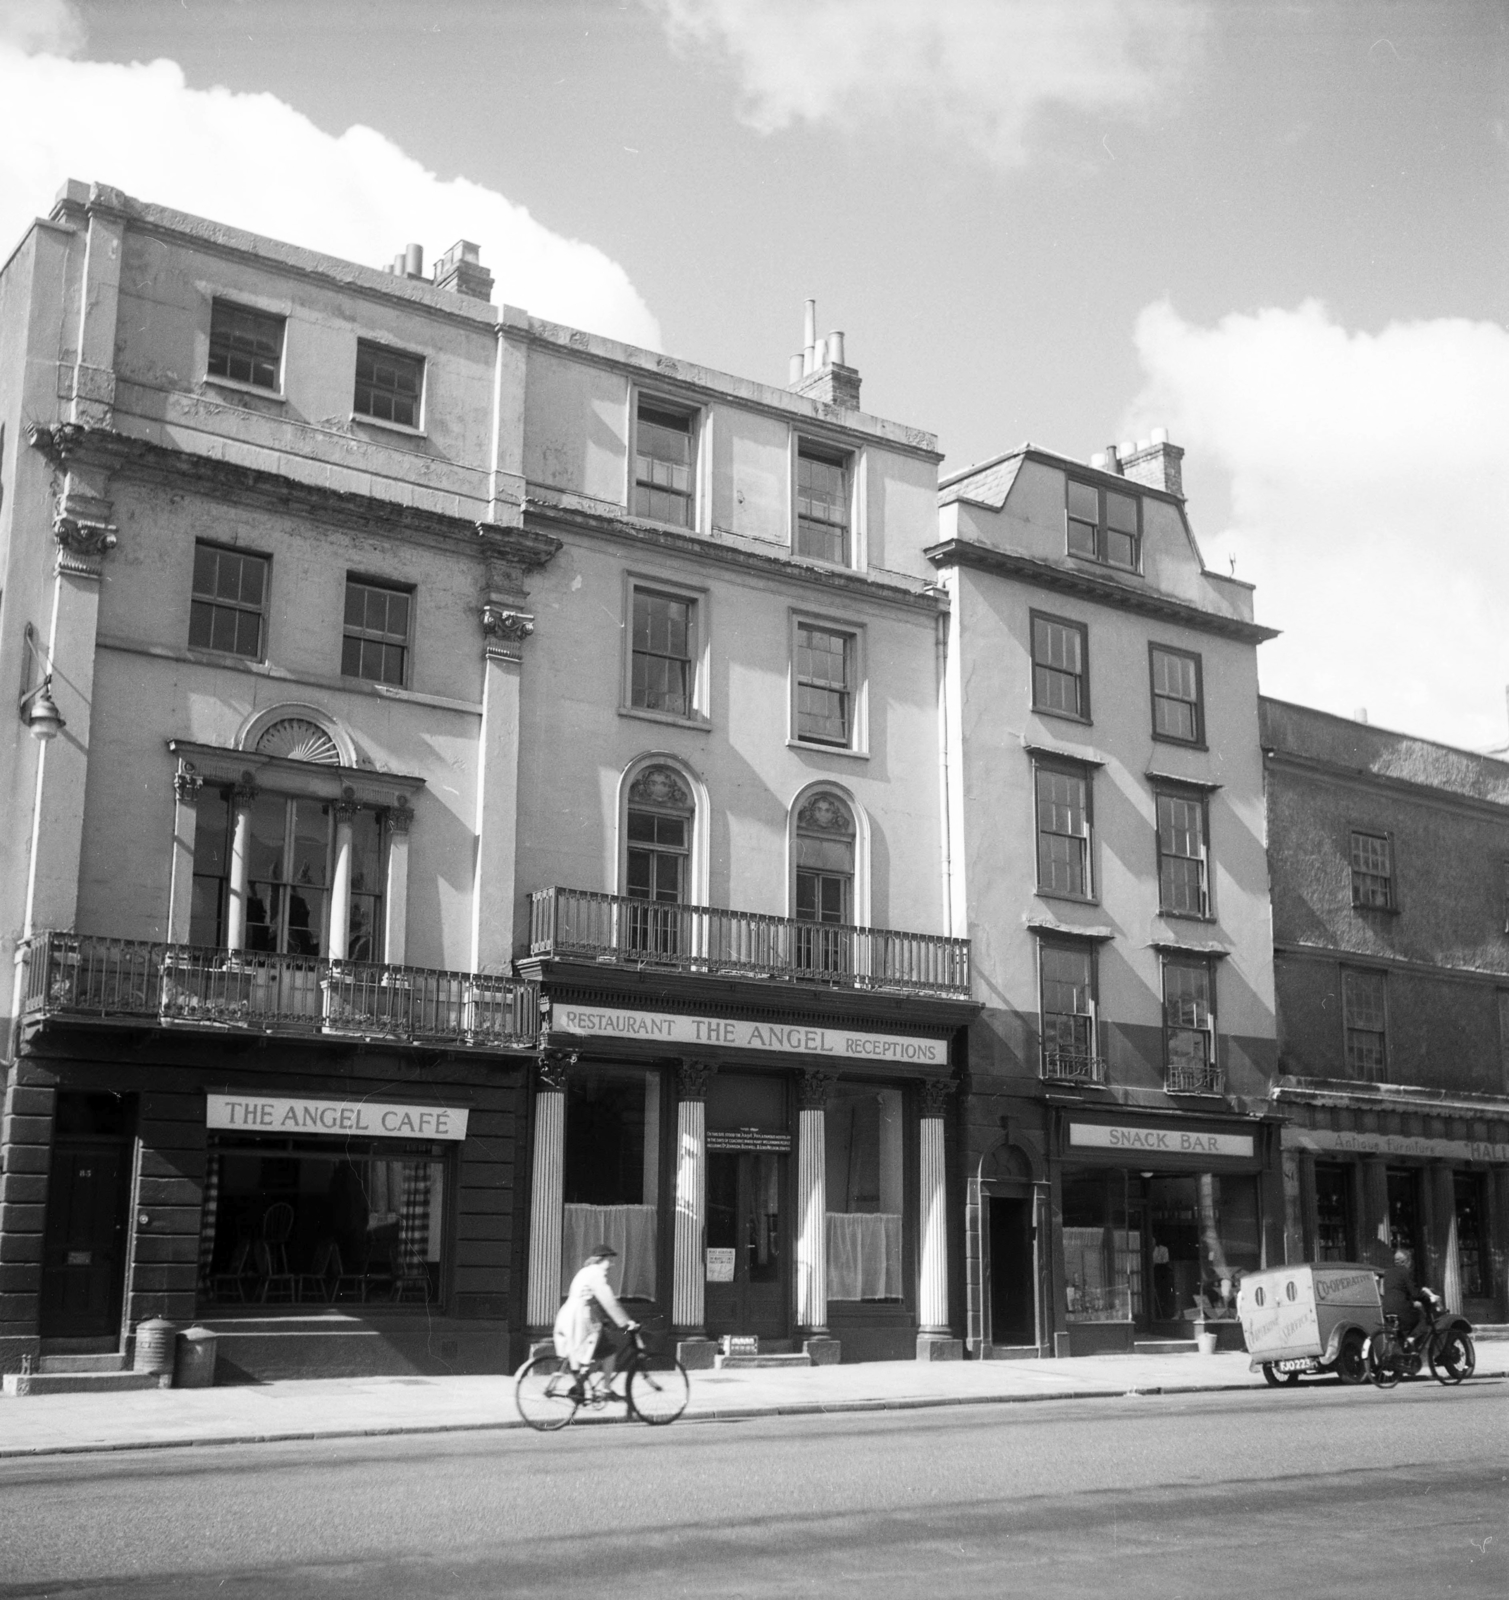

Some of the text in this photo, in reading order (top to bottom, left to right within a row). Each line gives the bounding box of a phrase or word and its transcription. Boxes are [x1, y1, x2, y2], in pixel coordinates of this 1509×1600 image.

[566, 1011, 936, 1061] RESTAURANT THE ANGEL RECEPTIONS
[224, 1102, 450, 1134] THE ANGEL CAFÉ
[1109, 1129, 1219, 1151] SNACK BAR
